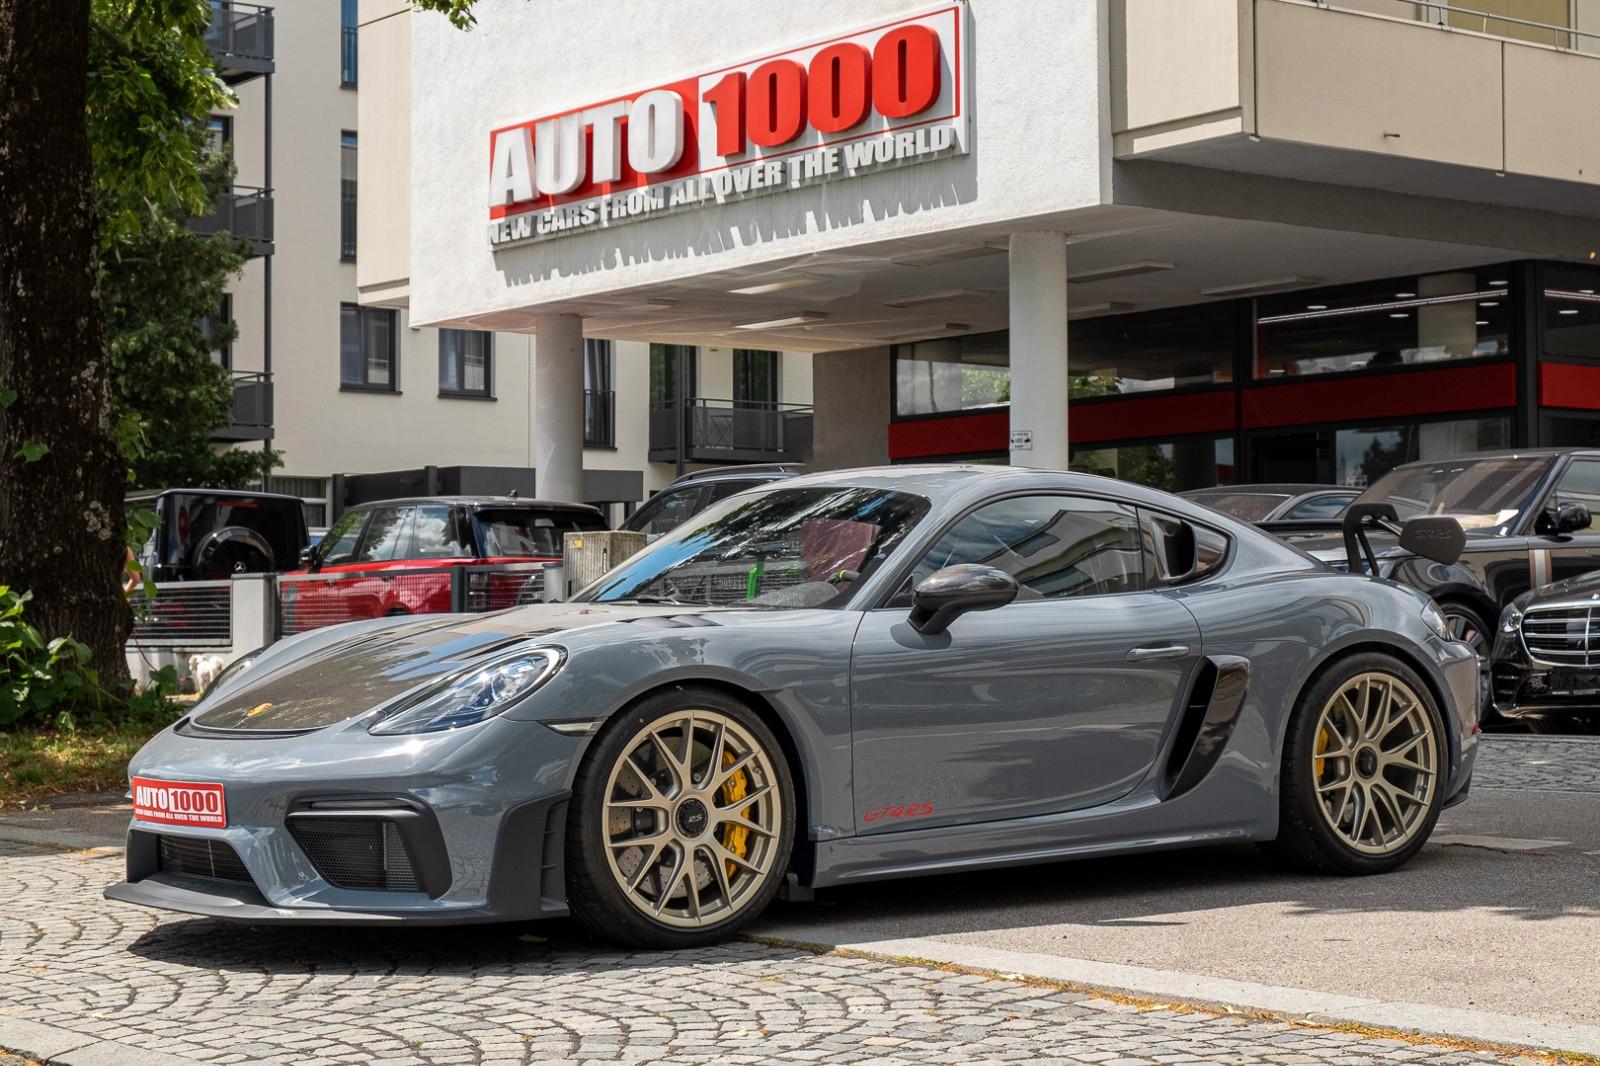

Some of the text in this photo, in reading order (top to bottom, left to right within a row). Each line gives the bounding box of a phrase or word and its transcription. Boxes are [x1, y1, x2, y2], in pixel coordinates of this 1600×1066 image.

[488, 24, 941, 207] AUTO 1000
[489, 126, 953, 244] NEW CARS FROM ALL OVER THE WORLD
[136, 785, 218, 813] AUTO 1000
